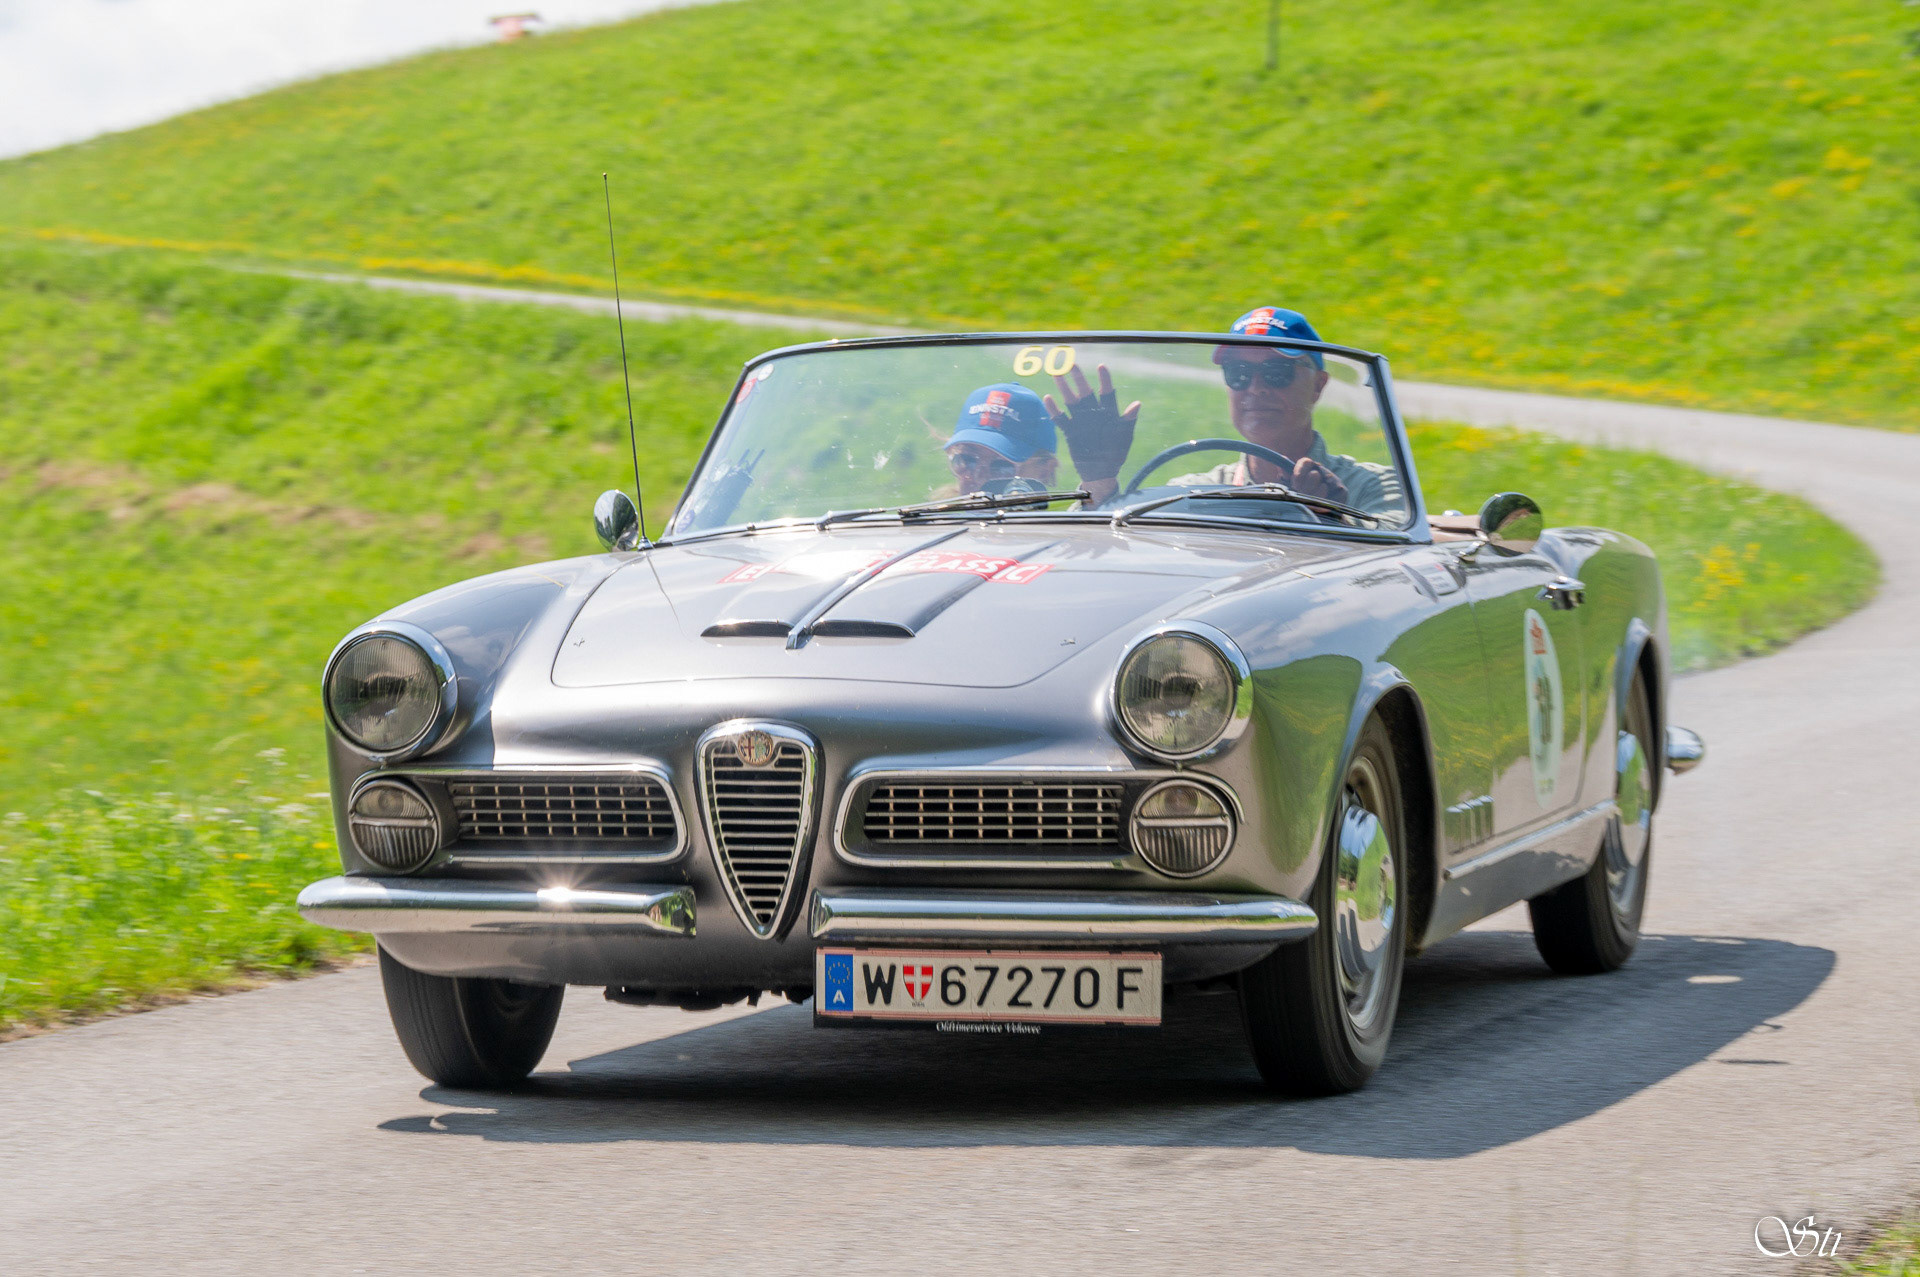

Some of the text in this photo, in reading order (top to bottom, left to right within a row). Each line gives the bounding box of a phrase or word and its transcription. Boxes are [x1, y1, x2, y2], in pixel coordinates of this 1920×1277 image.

[1013, 345, 1076, 377] 60
[901, 558, 1038, 581] CLASSIC
[832, 989, 846, 1004] A
[862, 963, 1144, 1010] W 67270 F
[936, 1021, 1003, 1033] Oldtimerservice
